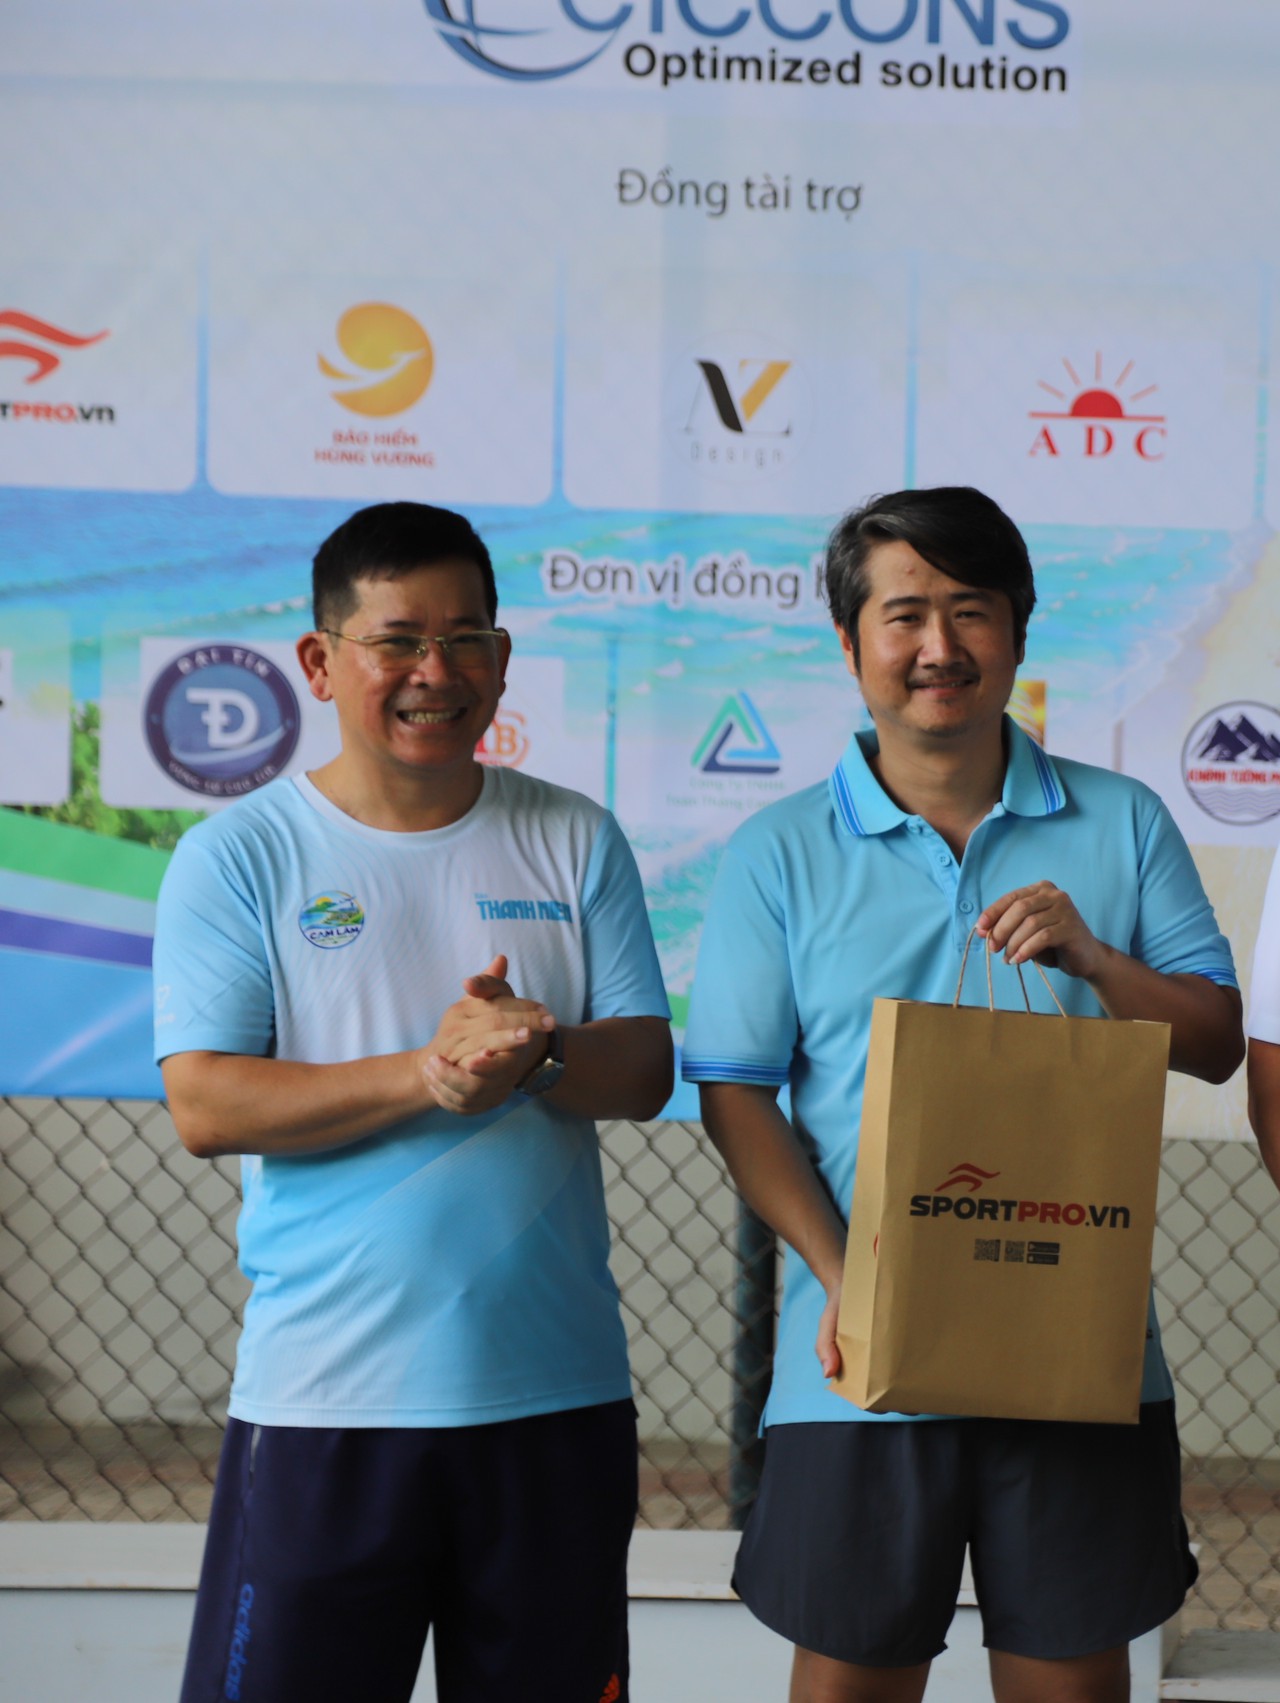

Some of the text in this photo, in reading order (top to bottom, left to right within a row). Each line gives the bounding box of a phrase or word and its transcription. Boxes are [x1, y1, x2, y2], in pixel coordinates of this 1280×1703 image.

[624, 43, 1067, 92] Optimized solution
[616, 165, 862, 222] Đồng tài trợ
[550, 555, 633, 592] Đơn
[648, 560, 679, 604] vị
[694, 558, 799, 609] đồng
[225, 1583, 254, 1701] adidas
